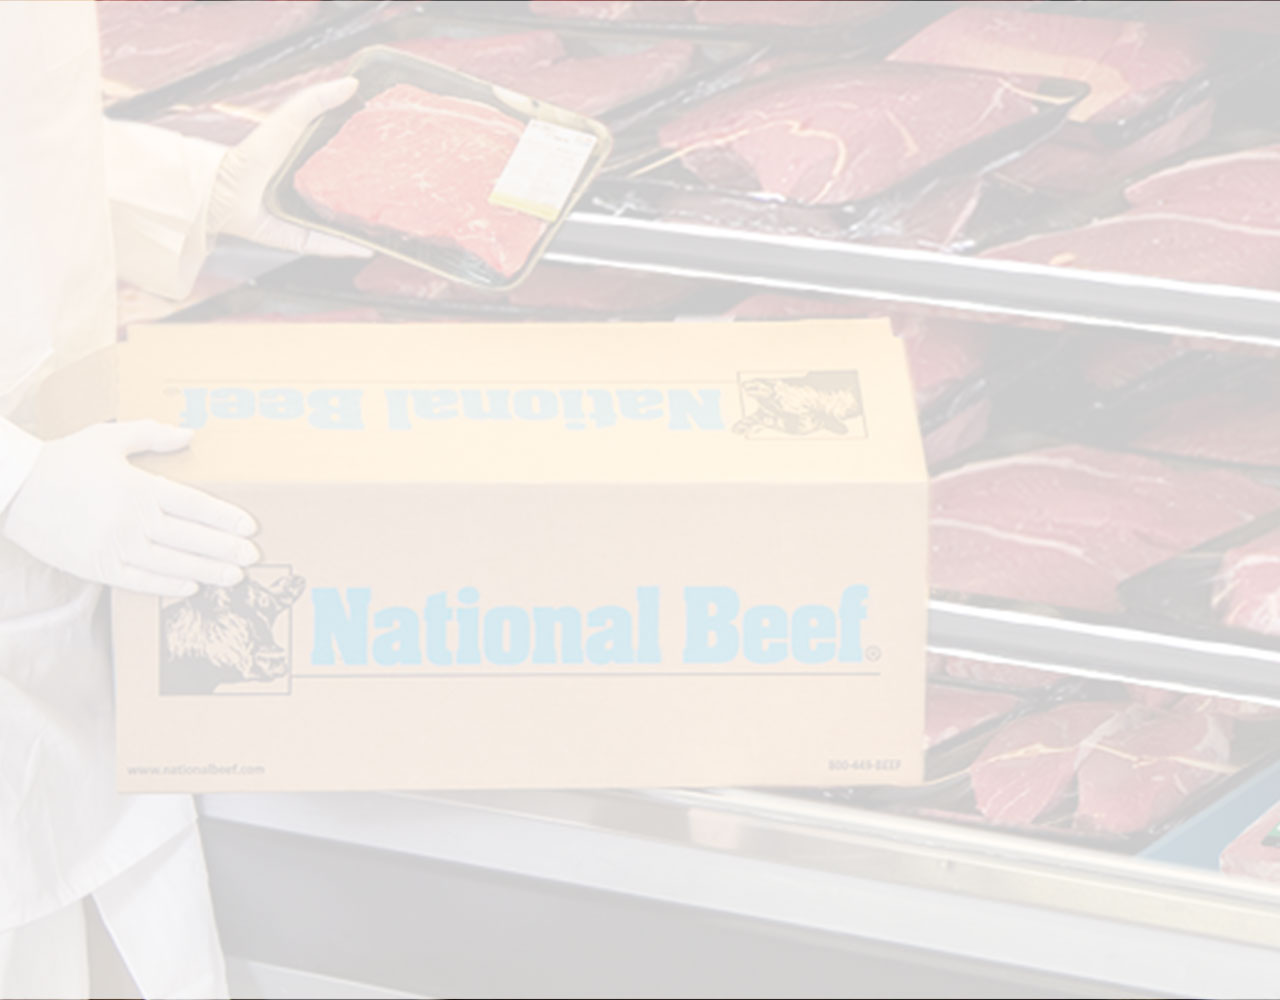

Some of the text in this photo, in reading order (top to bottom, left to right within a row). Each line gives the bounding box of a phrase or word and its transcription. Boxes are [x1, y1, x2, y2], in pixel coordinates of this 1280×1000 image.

[180, 386, 725, 431] National Beef
[310, 582, 869, 666] National Beef
[127, 763, 266, 775] www.nationalbeef.com
